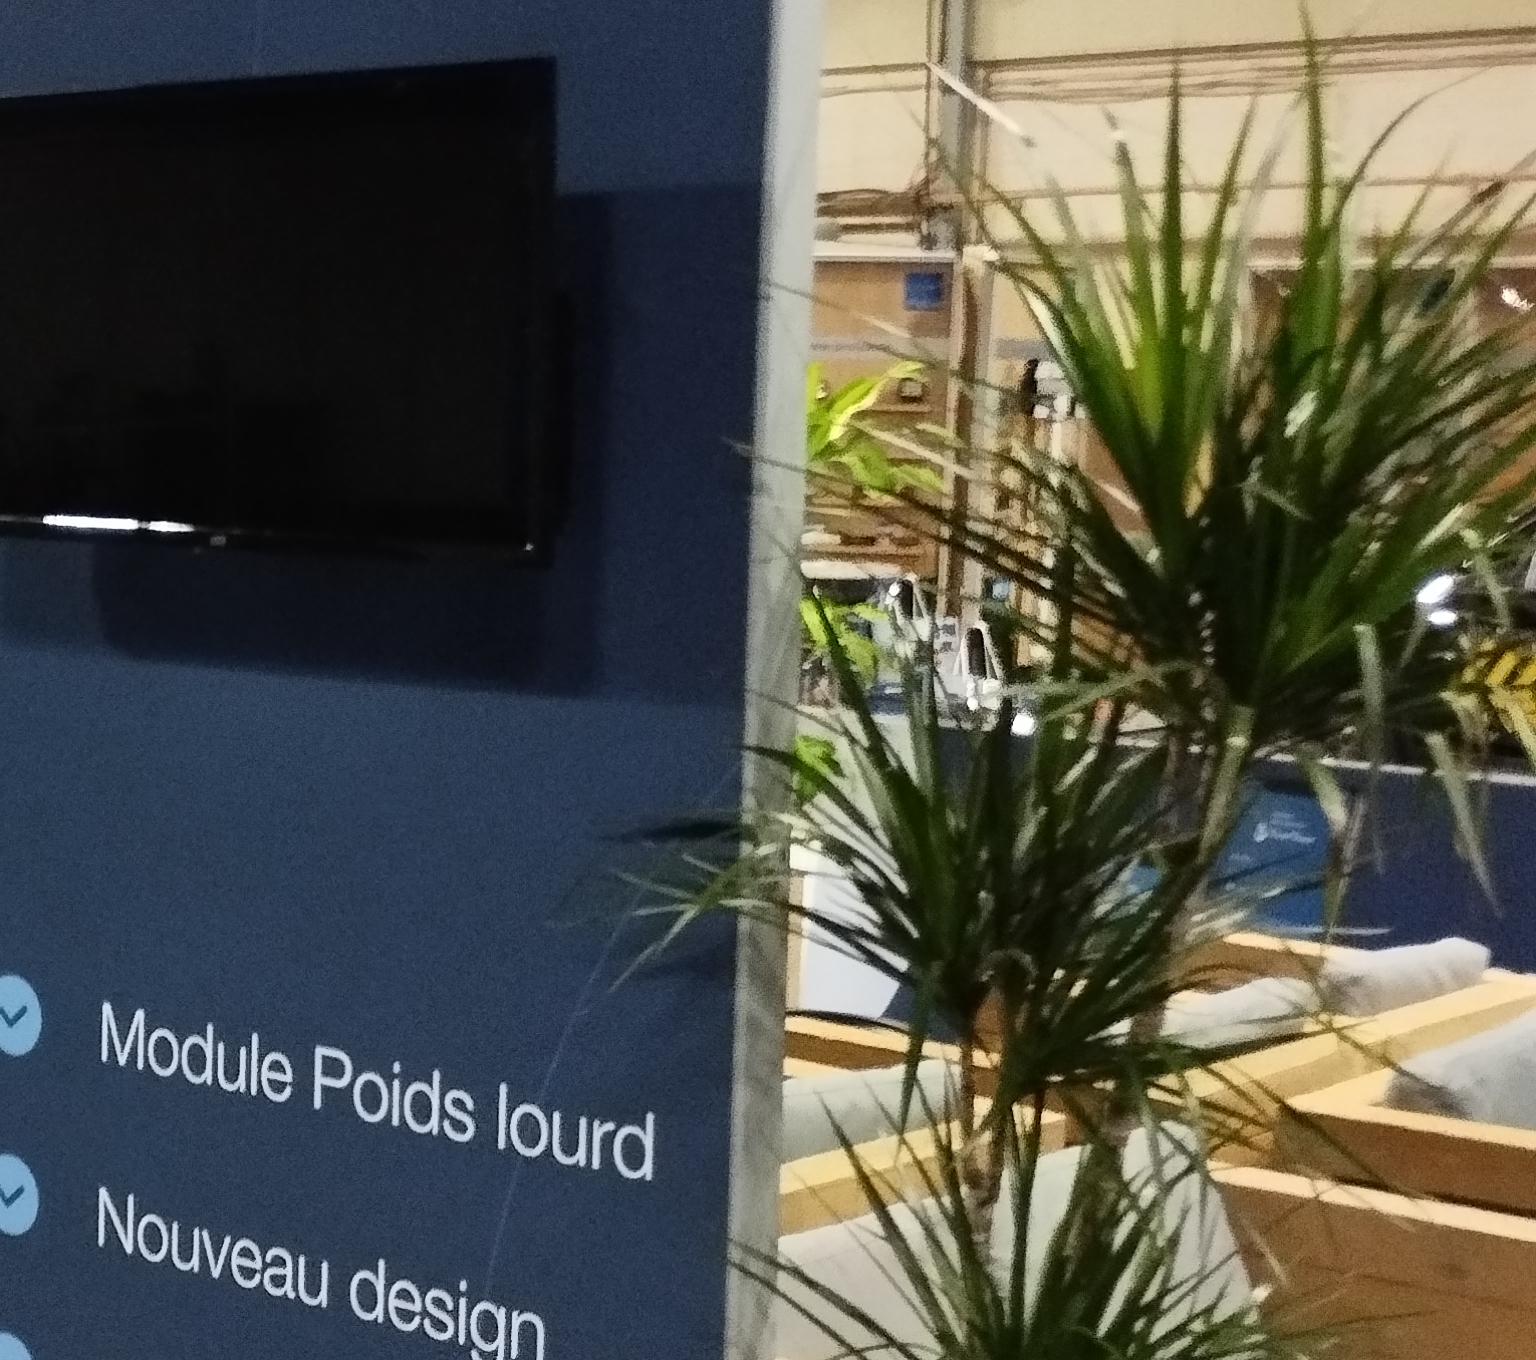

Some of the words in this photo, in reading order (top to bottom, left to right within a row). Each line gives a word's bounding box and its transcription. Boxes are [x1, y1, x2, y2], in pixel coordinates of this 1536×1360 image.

[100, 1001, 294, 1103] Module
[313, 1044, 477, 1143] Poids
[497, 1081, 656, 1181] lourd
[97, 1186, 330, 1309] Nouveau
